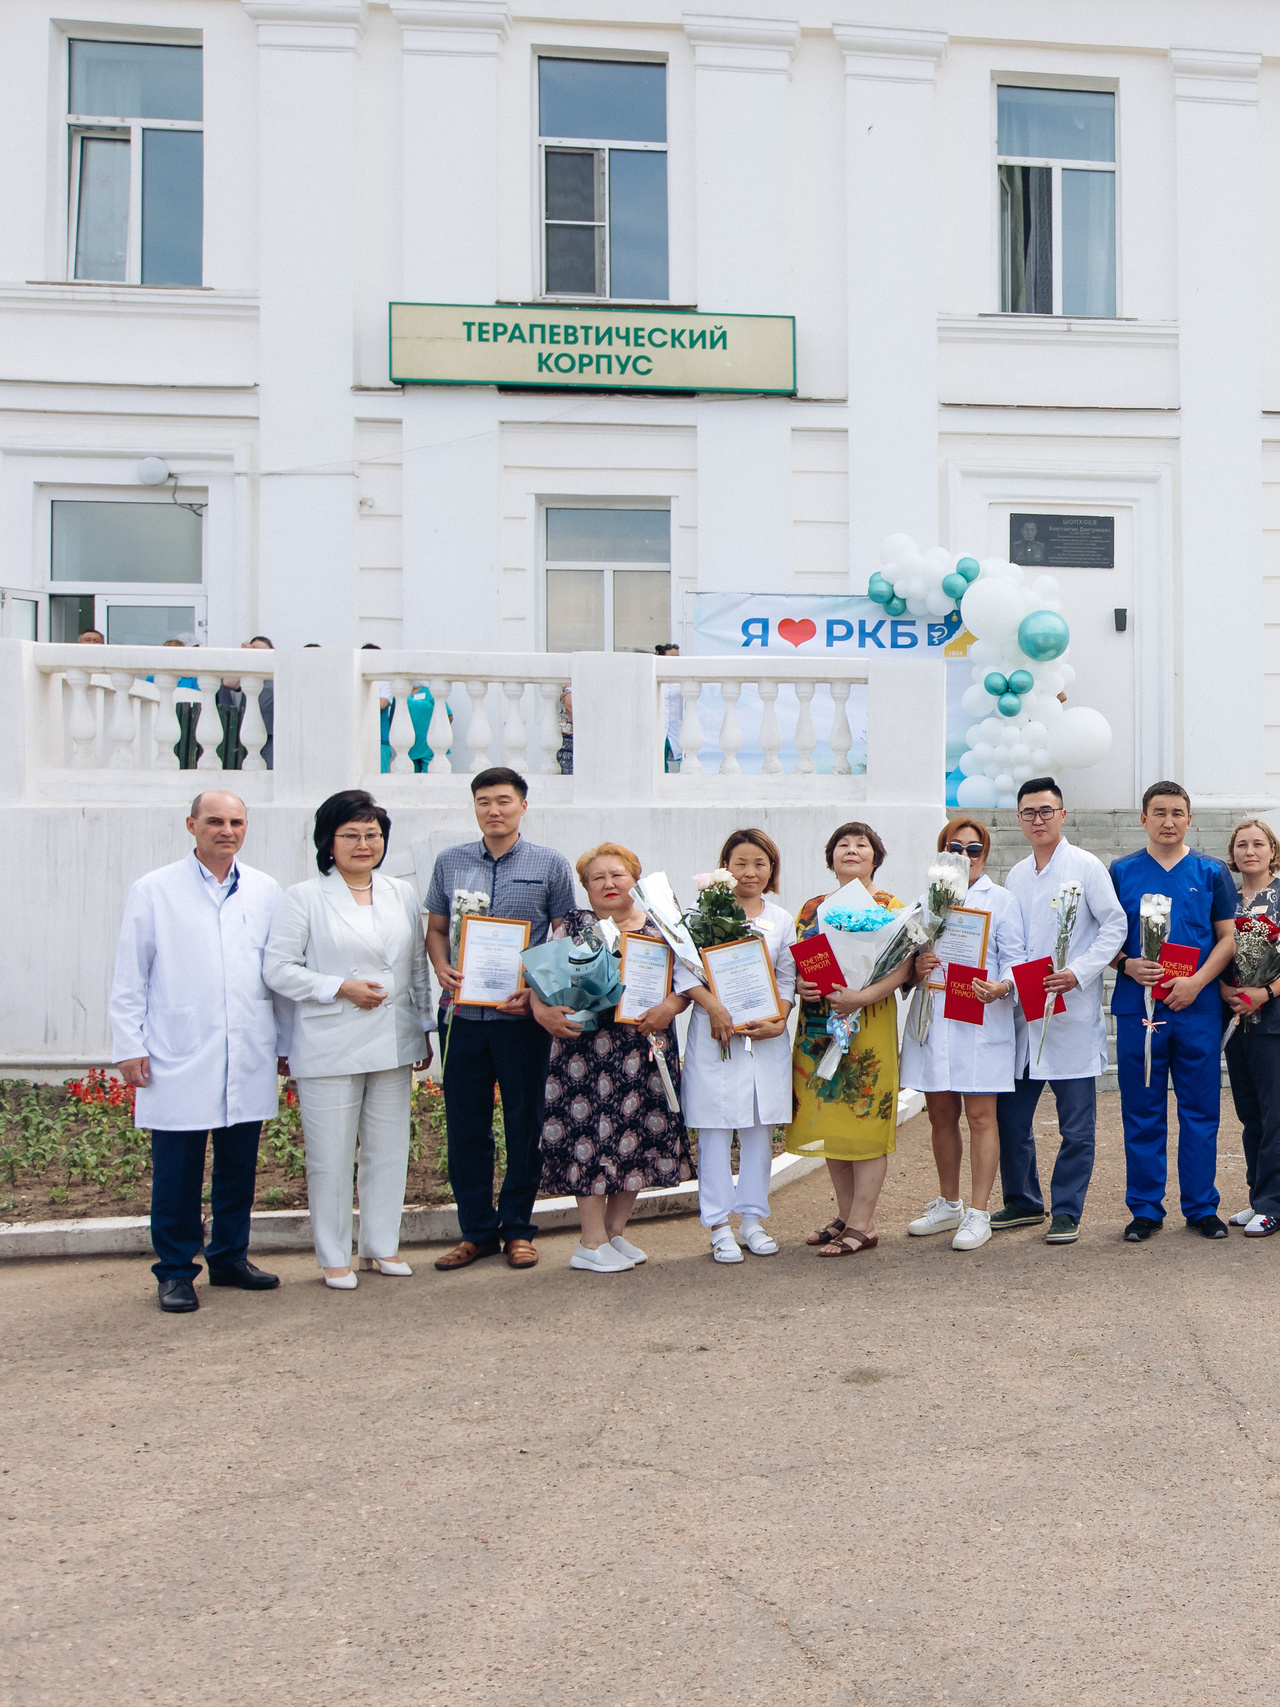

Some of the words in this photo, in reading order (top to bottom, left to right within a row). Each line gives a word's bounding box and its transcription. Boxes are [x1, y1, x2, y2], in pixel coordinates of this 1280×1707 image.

[462, 321, 728, 351] ТЕРАПЕВТИЧЕСКИЙ
[537, 352, 653, 376] КОРПУС
[1062, 518, 1098, 526] ШОПХОЕВ
[1079, 526, 1111, 534] Дмитриевич
[741, 617, 770, 648] Я
[825, 618, 919, 649] РКБ
[799, 951, 830, 968] ПОЧЕТНАЯ
[803, 959, 831, 975] ГРАМОТА
[1162, 960, 1193, 972] ПОЧЕТНАЯ
[951, 988, 977, 999] ГРАМОТ
